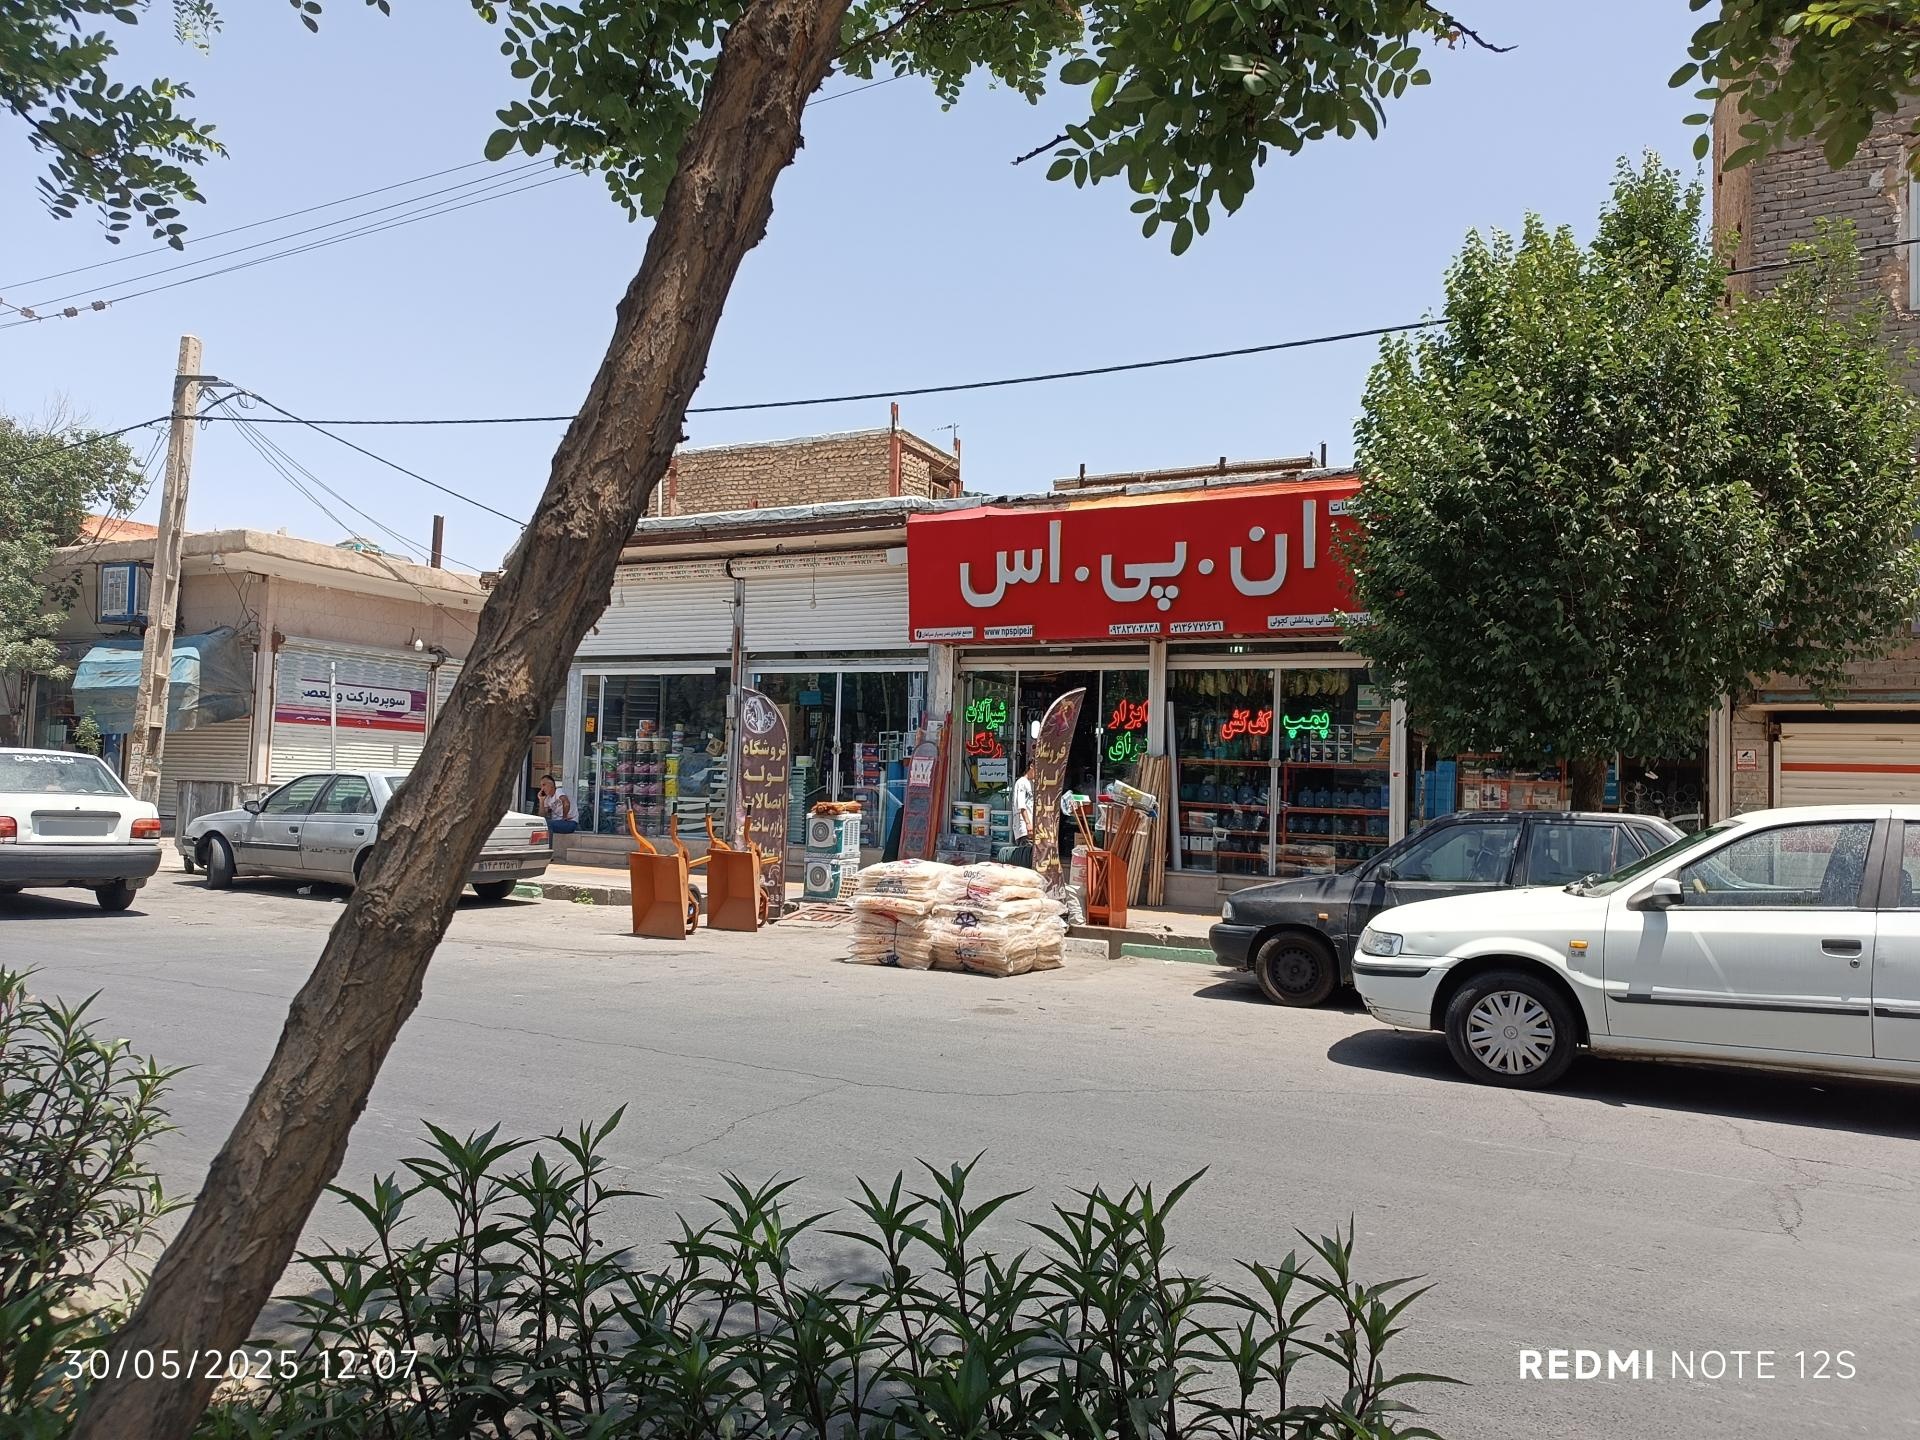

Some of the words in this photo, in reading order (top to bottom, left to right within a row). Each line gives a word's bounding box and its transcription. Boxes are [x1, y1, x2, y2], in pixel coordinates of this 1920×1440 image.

[346, 691, 406, 708] سوپرمارکت
[966, 698, 1006, 729] شیرآلات
[1108, 700, 1149, 729] ابزار
[1222, 709, 1250, 739] کش
[1248, 710, 1272, 734] کف
[1284, 712, 1330, 739] پمپ
[743, 739, 787, 761] فروشگاه
[966, 732, 1005, 758] رنگ
[743, 765, 785, 787] لوله
[742, 793, 786, 810] اتصالات
